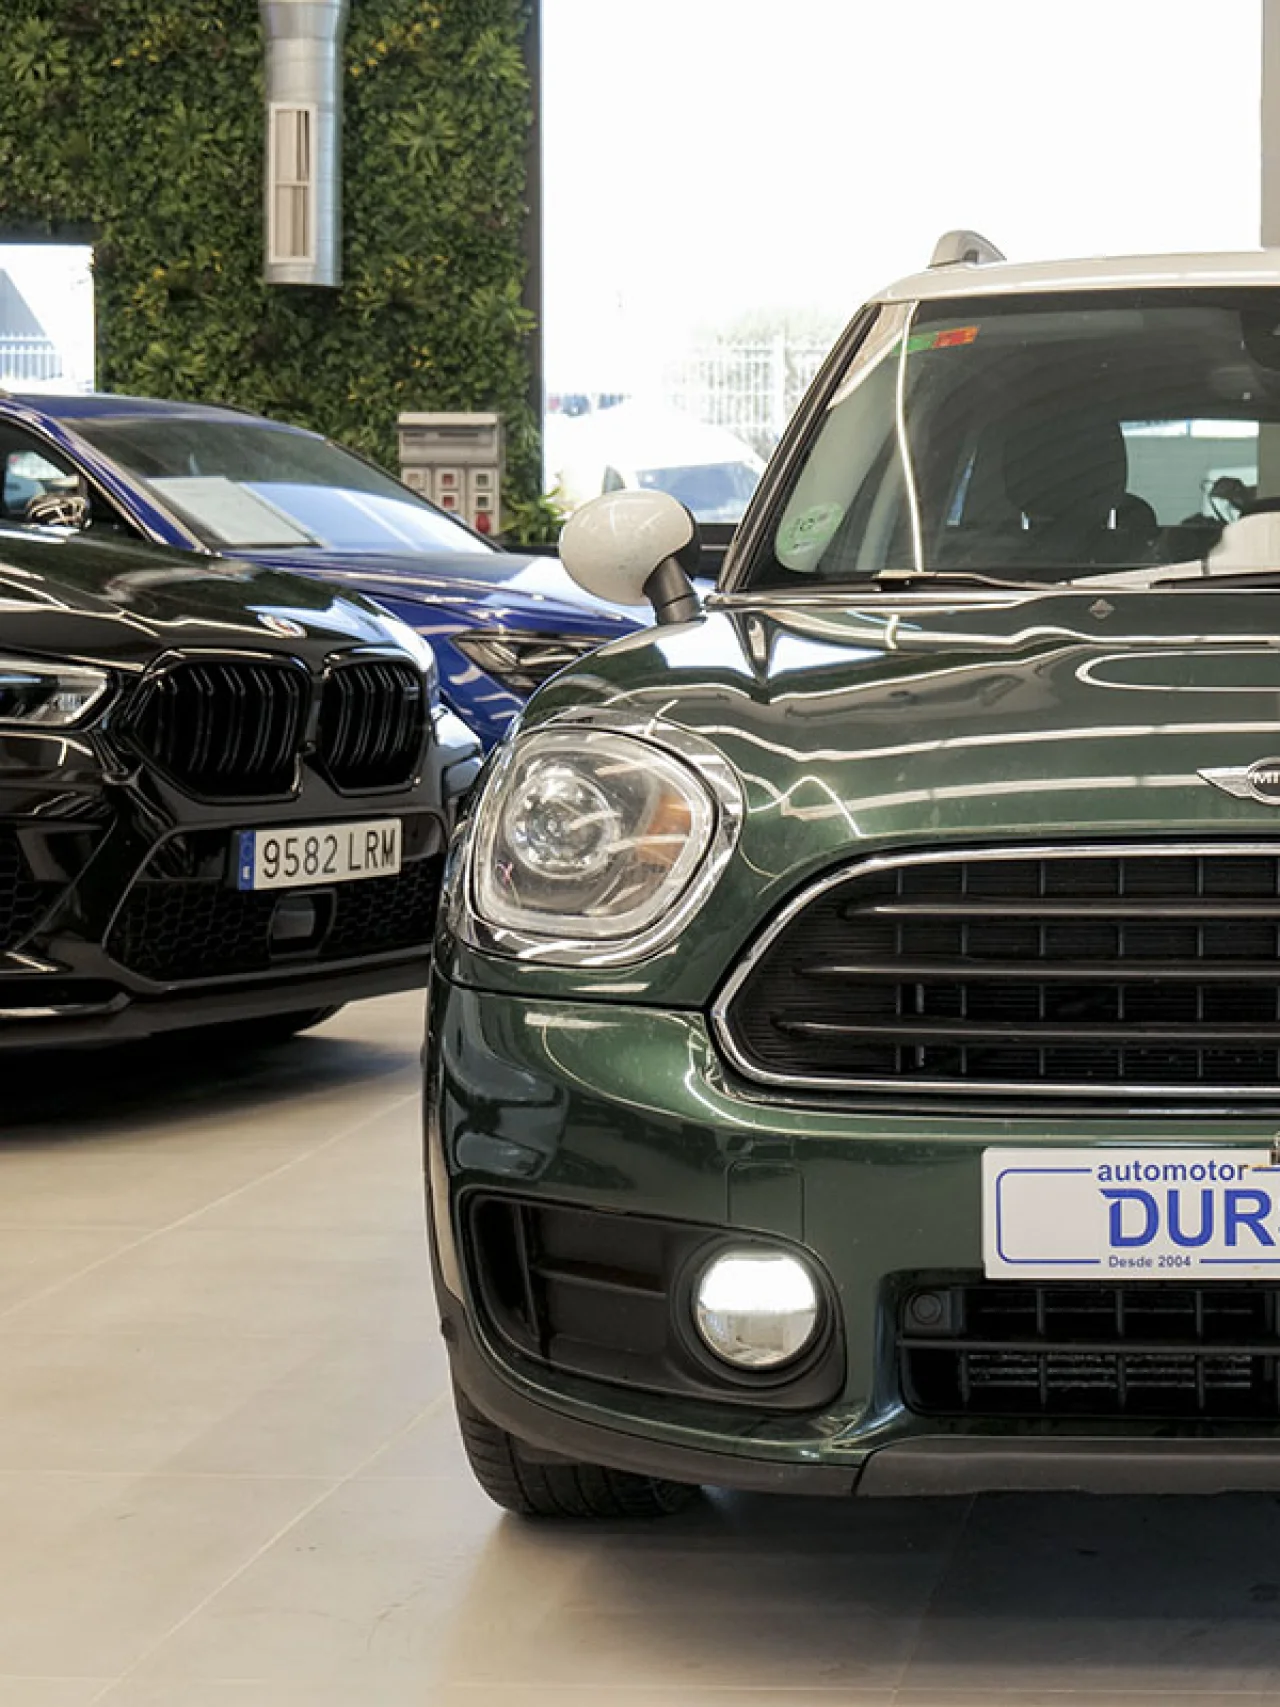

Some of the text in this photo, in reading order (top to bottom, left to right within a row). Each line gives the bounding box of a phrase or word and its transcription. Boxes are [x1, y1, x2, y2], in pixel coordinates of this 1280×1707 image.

[263, 827, 396, 880] 9582 LRM
[1097, 1160, 1248, 1183] automotor
[1108, 1254, 1192, 1268] Desde 2004
